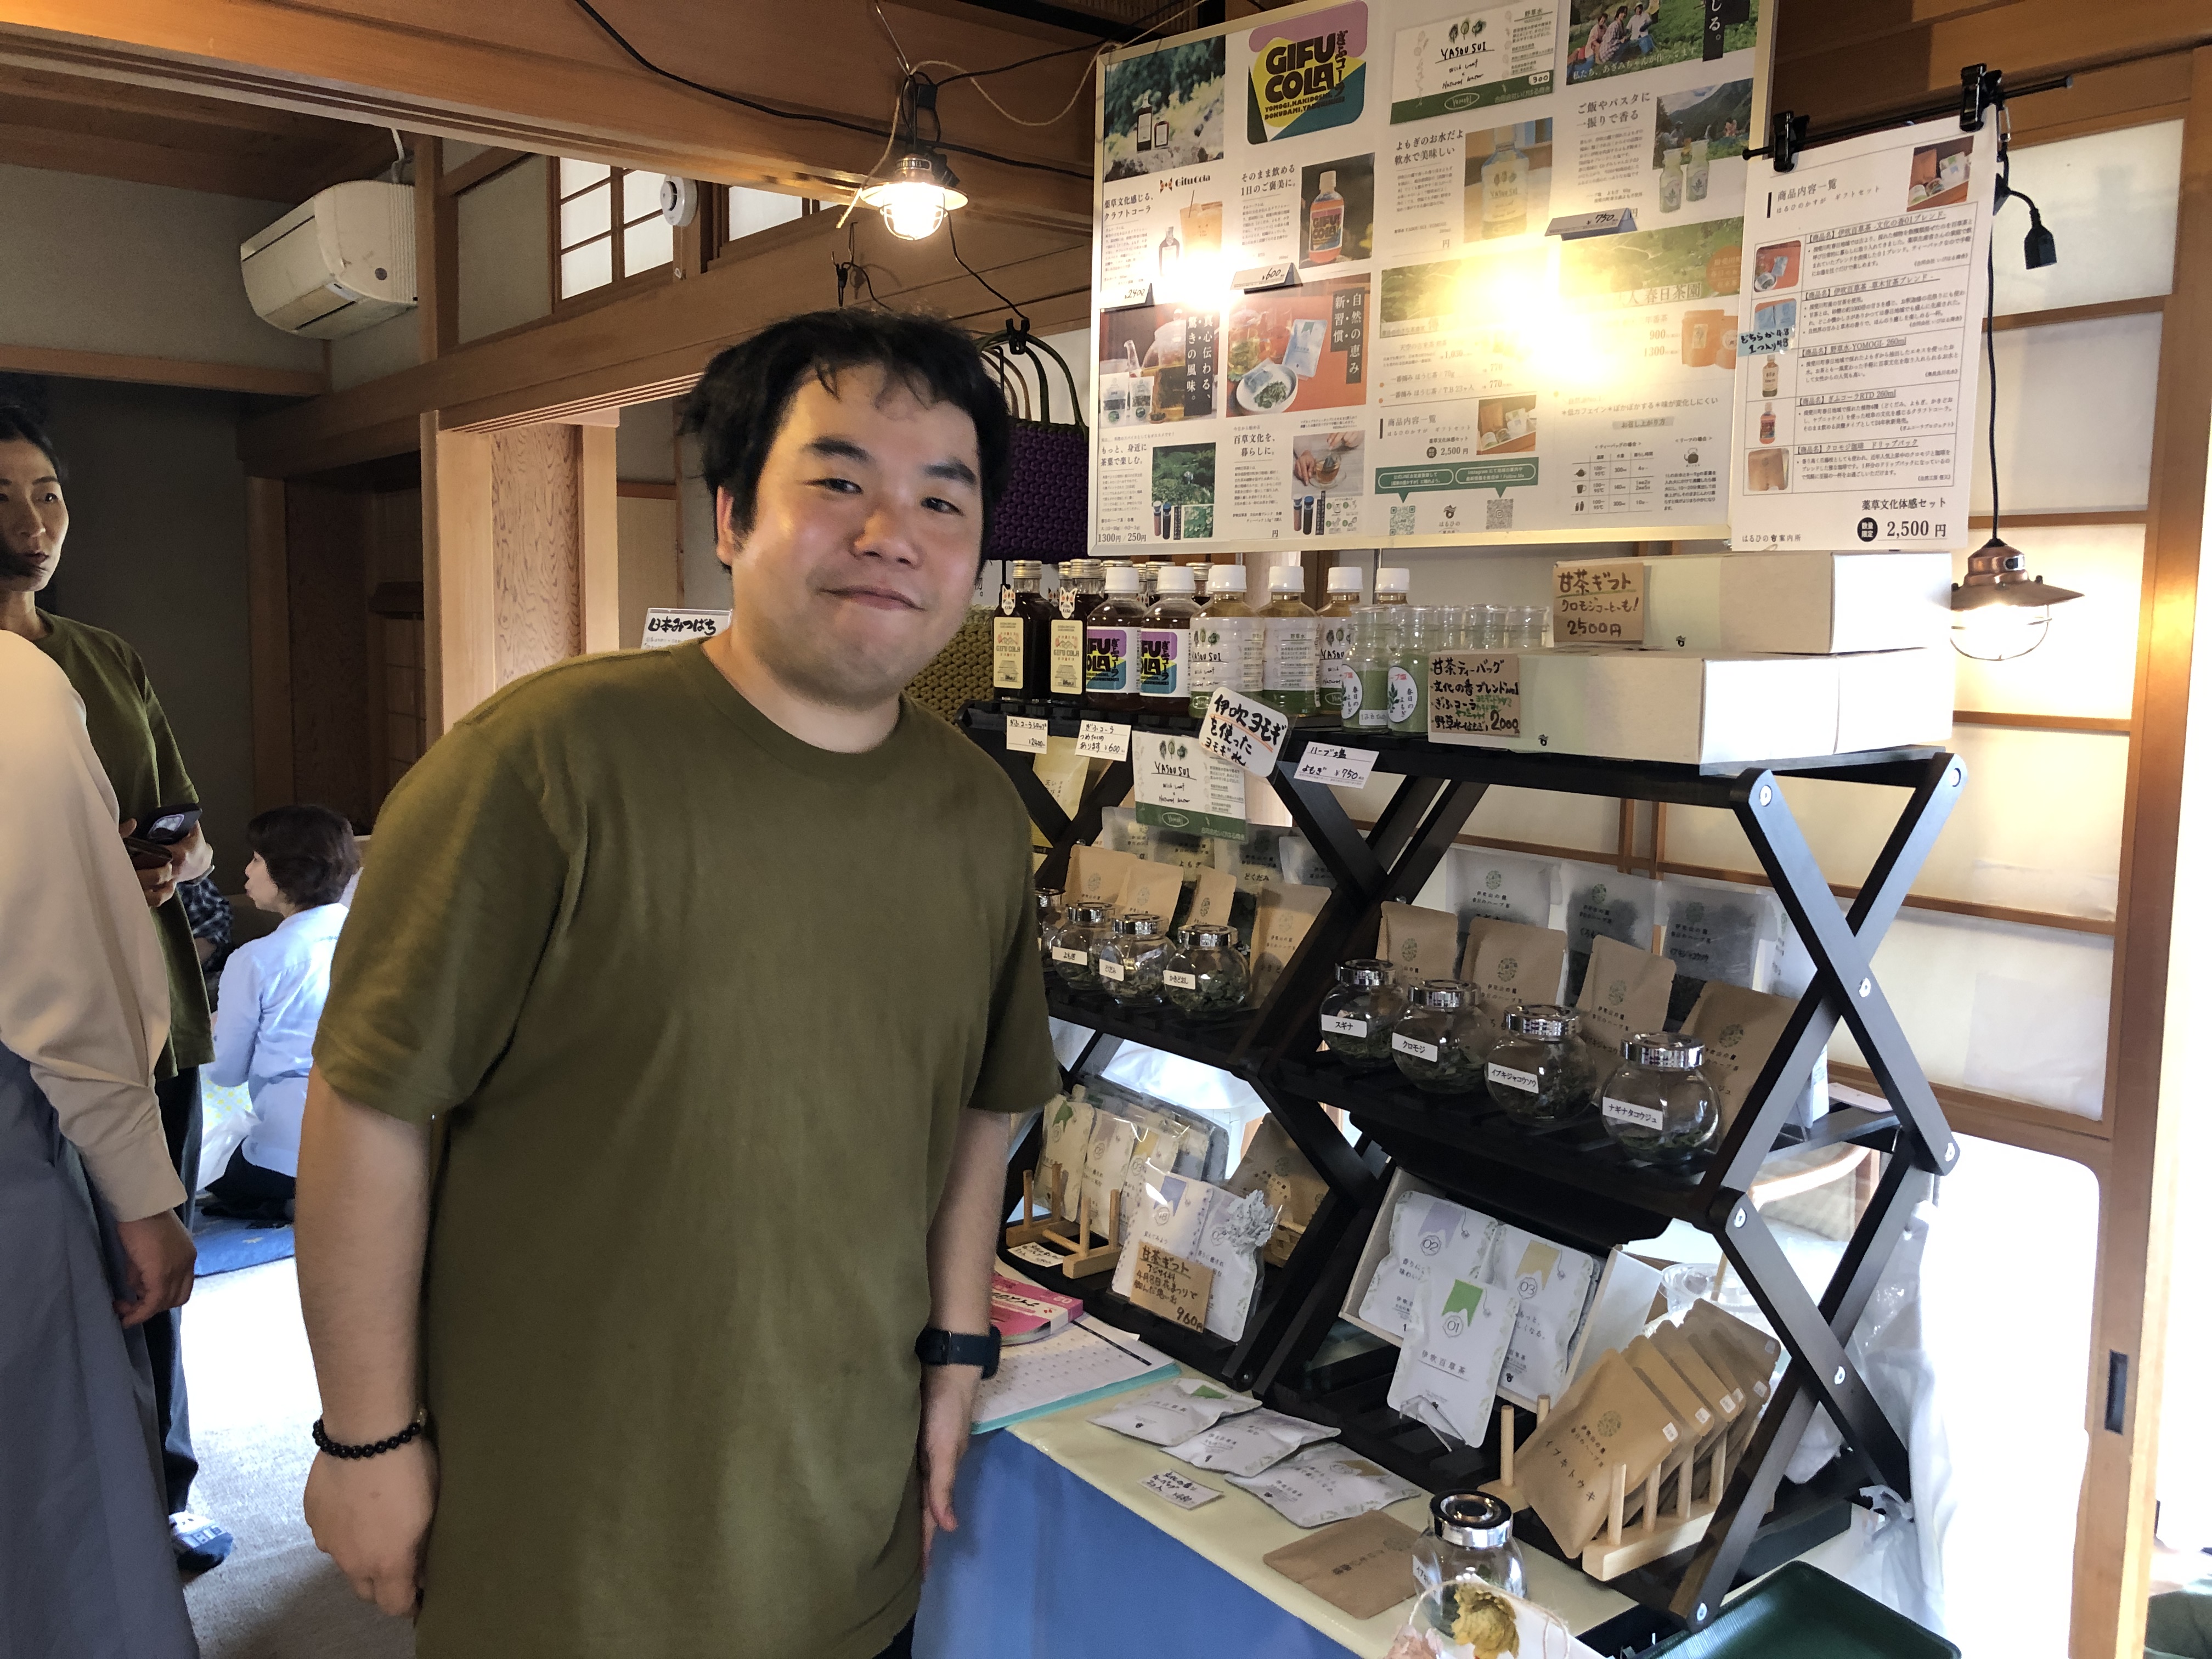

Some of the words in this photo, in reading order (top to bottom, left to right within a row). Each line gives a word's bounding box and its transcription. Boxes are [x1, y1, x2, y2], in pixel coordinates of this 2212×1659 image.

[1266, 32, 1336, 75] GIFU
[1441, 46, 1469, 60] YASOU
[1471, 42, 1487, 53] SUI
[1334, 30, 1348, 97] ぎふコーラ
[1265, 62, 1335, 103] COLA
[1532, 75, 1549, 83] 300
[1578, 92, 1651, 114] ご飯やパスタに
[1577, 110, 1639, 128] 一振りで香る
[1396, 129, 1463, 151] よもぎのお水だよ
[1395, 148, 1455, 166] 軟水で美味しい
[1242, 164, 1295, 182] そのまま飲める
[1240, 179, 1296, 196] 1日のご褒美に。
[1777, 178, 1838, 202] 商品内容一覧
[1104, 193, 1154, 210] 薬草文化感じる、
[1776, 197, 1827, 214] はるひのかすが
[1834, 185, 1881, 201] ギフトセット
[1104, 205, 1151, 221] クラフトコーラ
[1442, 239, 1450, 249] 円
[1645, 282, 1701, 305] 春日茶園
[1333, 295, 1346, 344] 新習慣
[1349, 292, 1362, 374] 自然の恵み
[1649, 329, 1666, 340] 900
[1886, 336, 1907, 347] 260ml
[1186, 316, 1198, 400] 驚きの風味。
[1202, 314, 1214, 399] 真心伝わる、
[1644, 346, 1666, 357] 1300
[1391, 374, 1413, 383] 一番摘み
[1415, 371, 1437, 381] ほうじ茶
[1390, 390, 1412, 398] 一番摘み
[1414, 387, 1437, 396] ほうじ茶
[1489, 379, 1503, 388] 770
[1876, 388, 1897, 398] 260ml
[1387, 414, 1437, 428] 商品内容一覧
[1621, 418, 1666, 428] お召し上がり方
[1234, 432, 1276, 445] 百草文化を、
[1387, 428, 1429, 437] はるひのかすが
[1435, 425, 1471, 433] ギフトセット
[1429, 436, 1469, 444] 薬草文化体感セット
[1102, 443, 1147, 455] もっと、身近に
[1241, 446, 1275, 458] 暮らしに。
[1441, 447, 1461, 456] 2,500
[1101, 456, 1143, 467] 茶葉で楽しむ。
[1861, 497, 1946, 511] 薬草文化体感セット
[1098, 533, 1121, 543] 1300円
[1127, 532, 1147, 542] 250円
[1272, 529, 1279, 538] 円
[1886, 520, 1930, 539] 2,500
[1934, 523, 1948, 538] 円
[1742, 534, 1769, 543] はるひの
[1778, 533, 1802, 542] 案内所
[1557, 568, 1632, 596] 甘茶ギフト
[647, 616, 716, 636] 日本みつばち
[1567, 617, 1622, 637] 2500円
[1209, 652, 1221, 662] SUI
[1432, 657, 1505, 676] 甘茶ティーバッグ
[1435, 696, 1476, 710] ぎふコーラ
[1214, 693, 1287, 746] 伊吹ヨモギ
[1086, 723, 1115, 734] ぎふコーラ
[1210, 715, 1252, 755] を使った
[1080, 742, 1101, 753] あります
[1205, 737, 1246, 766] ヨモギ水
[1310, 747, 1347, 759] ハーブ塩
[1154, 760, 1176, 775] YASOU
[1179, 766, 1190, 778] SUI
[1302, 764, 1327, 776] よもぎ
[1334, 768, 1359, 780] ¥750
[1244, 872, 1270, 882] どくだみ
[1062, 951, 1076, 961] よもぎ
[1104, 964, 1117, 974] どくだみ
[1169, 974, 1189, 985] かきどおし
[1335, 1020, 1354, 1030] スギナ
[1403, 1040, 1426, 1054] クロモジ
[1491, 1068, 1537, 1088] イブキジャコウソウ
[1608, 1104, 1658, 1124] ナギナタコウジュ
[1132, 1161, 1142, 1172] 03
[1422, 1239, 1439, 1251] 02
[1142, 1245, 1189, 1273] 甘茶ギフト
[1146, 1263, 1176, 1282] アジサイ科
[1520, 1281, 1536, 1295] 03
[1177, 1306, 1204, 1332] 960円
[1446, 1321, 1461, 1331] 01
[1421, 1349, 1466, 1375] 伊吹百草茶
[1544, 1439, 1595, 1503] イブキトウキ
